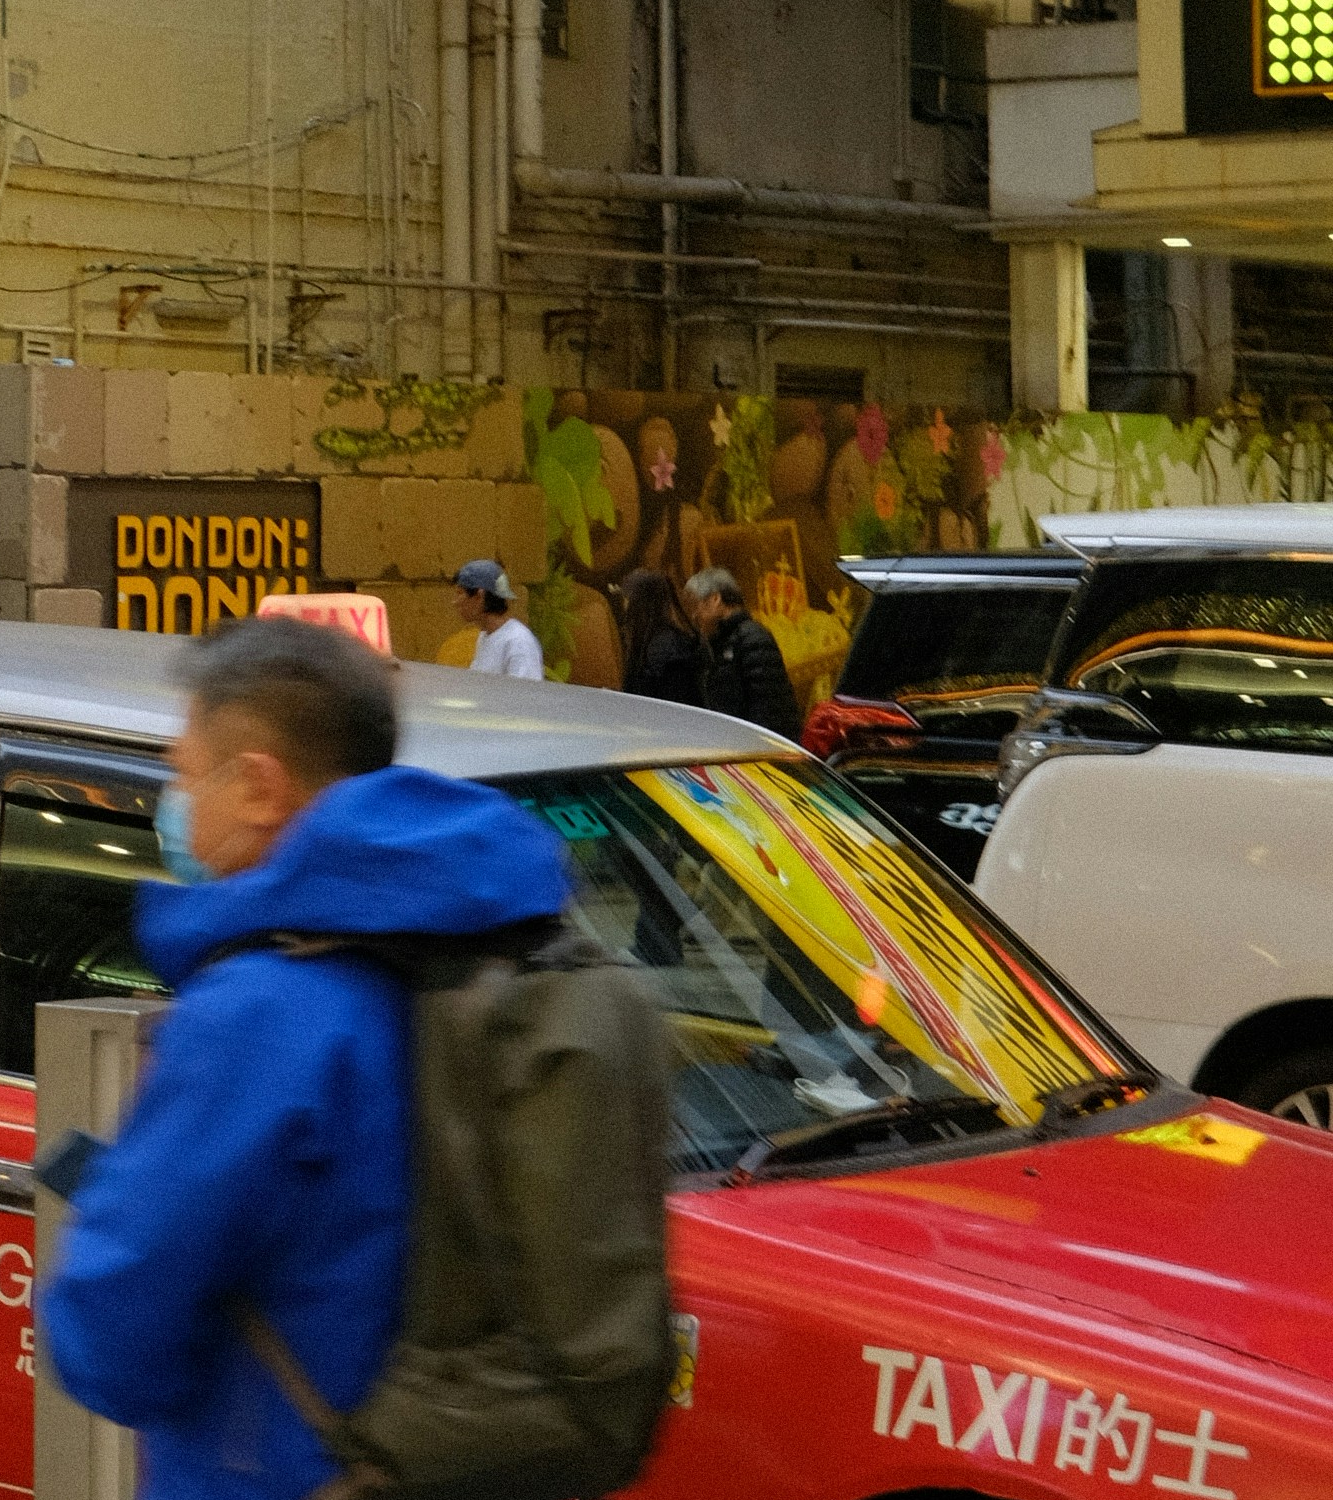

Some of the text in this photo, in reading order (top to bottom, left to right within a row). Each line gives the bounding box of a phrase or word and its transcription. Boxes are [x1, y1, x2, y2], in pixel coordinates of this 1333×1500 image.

[117, 514, 202, 569] DON
[117, 575, 309, 637] DON
[861, 1344, 1050, 1466] TAXI
